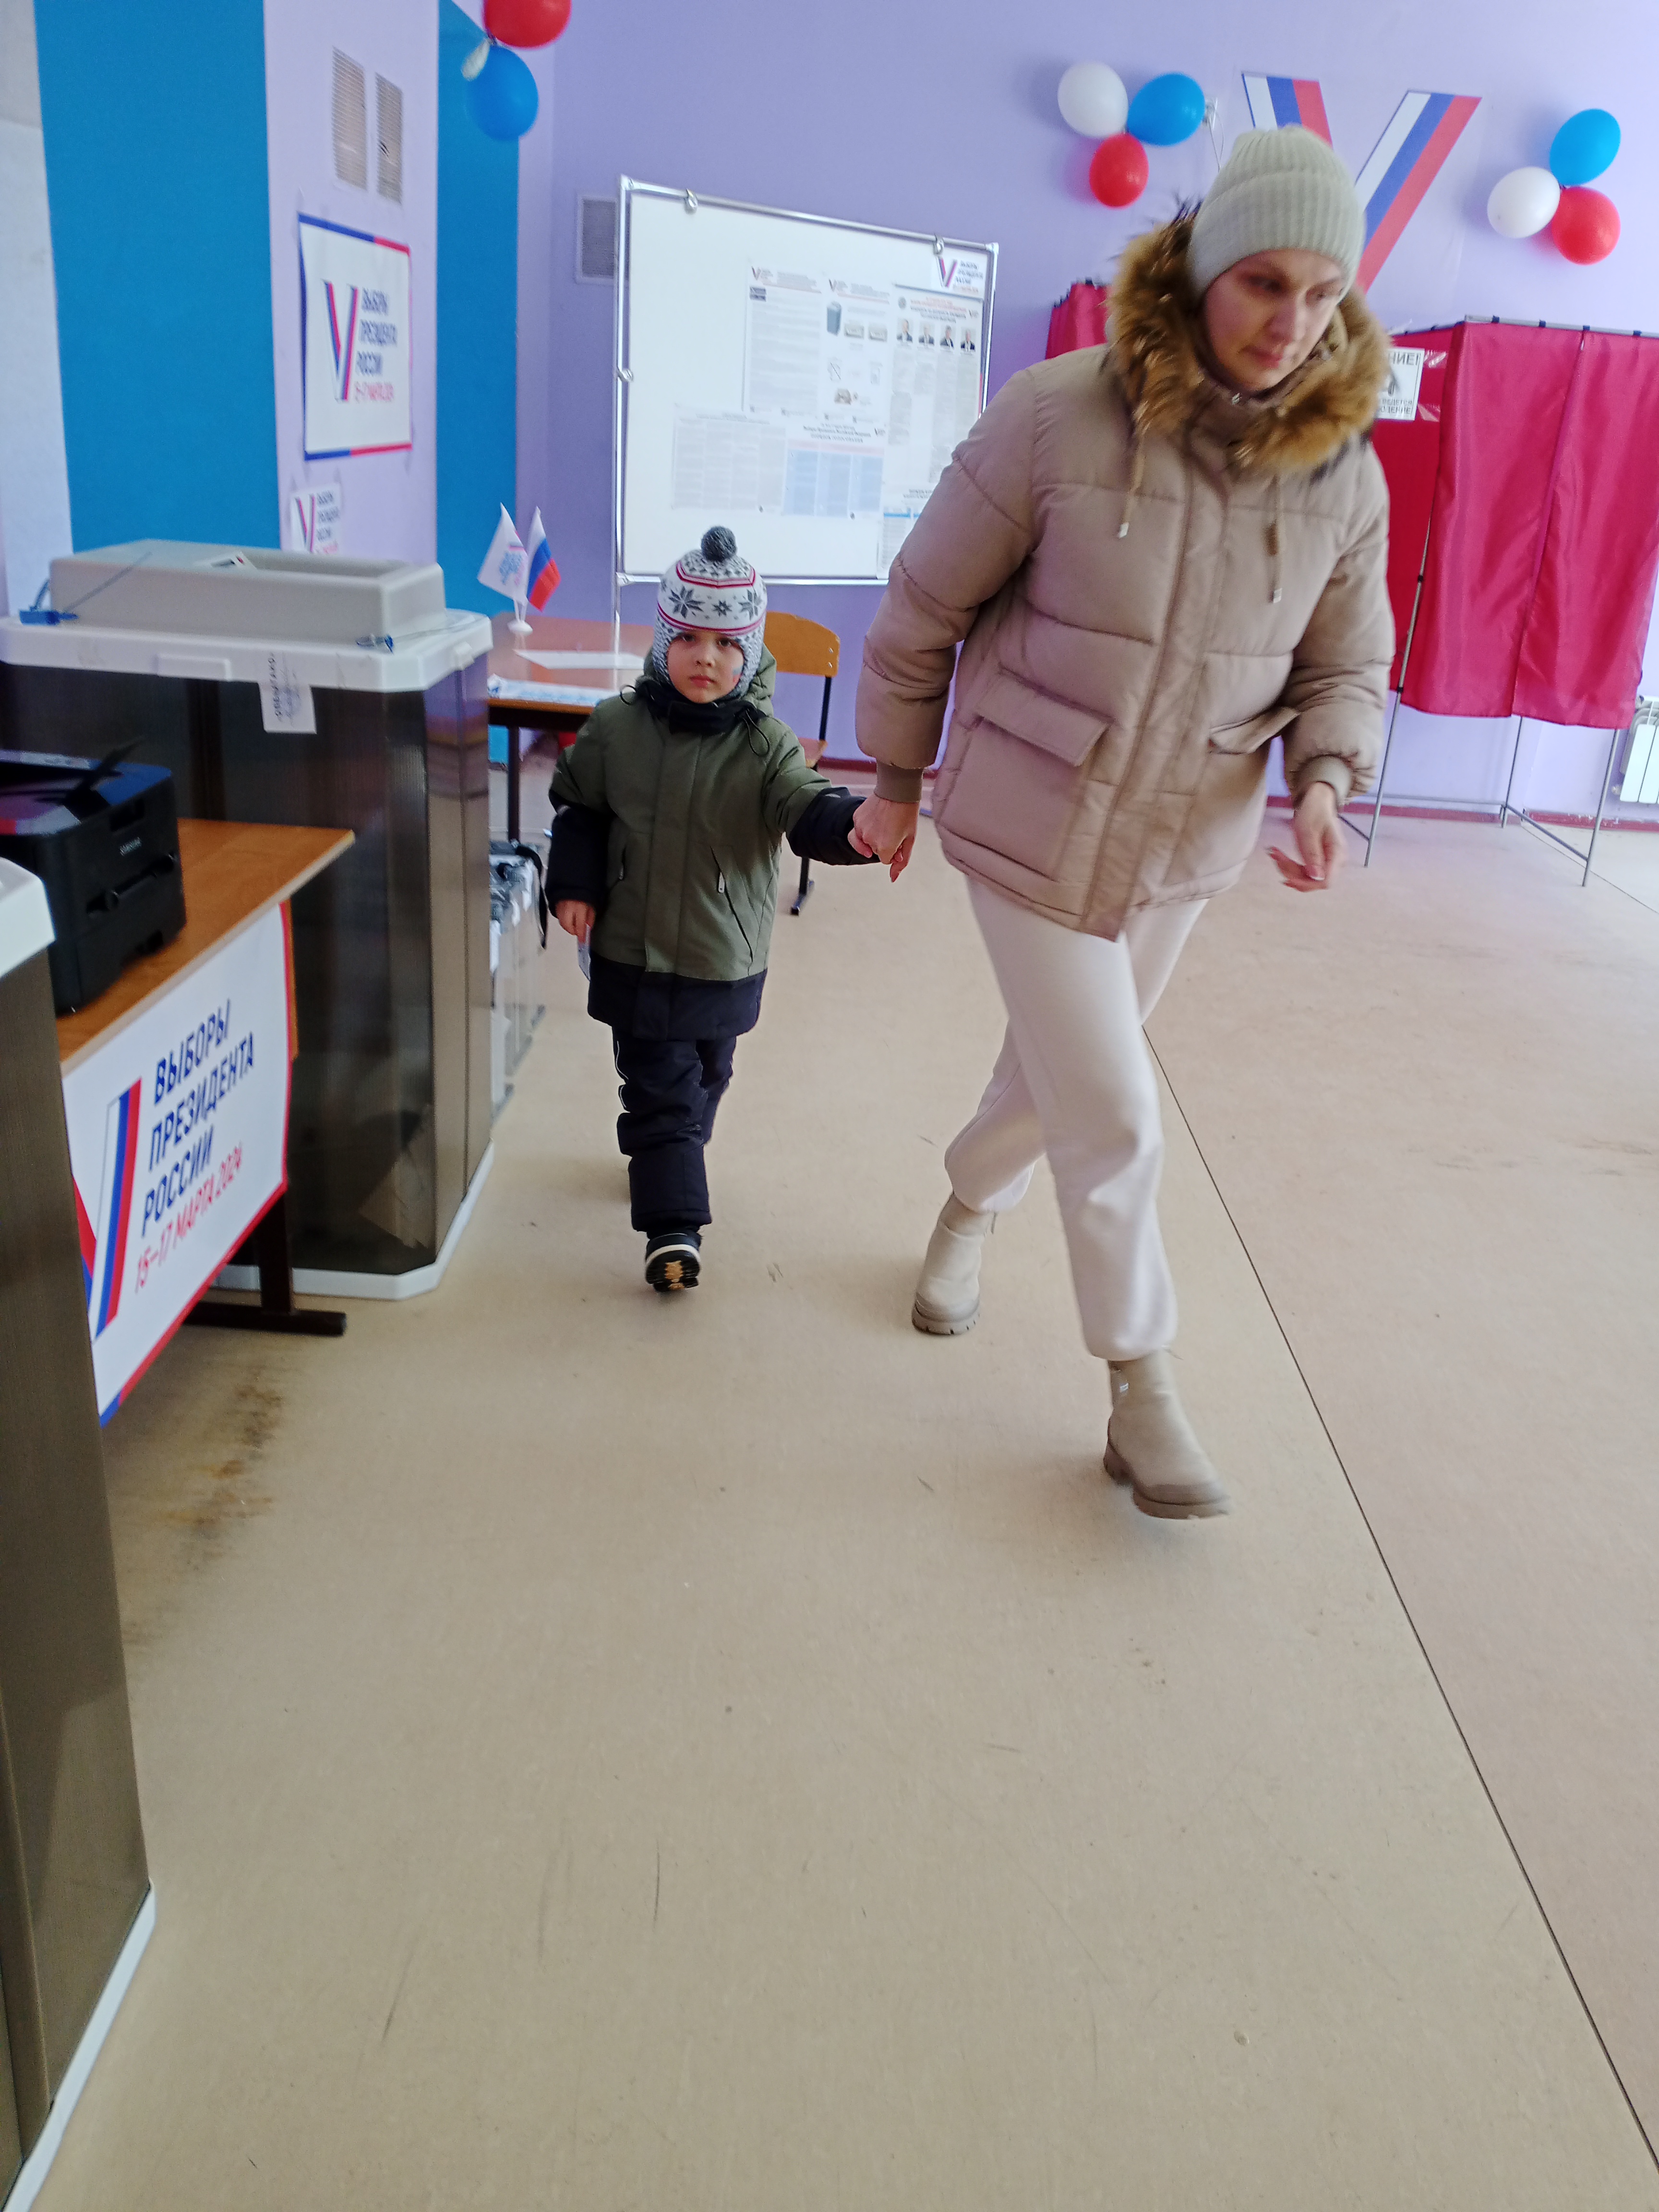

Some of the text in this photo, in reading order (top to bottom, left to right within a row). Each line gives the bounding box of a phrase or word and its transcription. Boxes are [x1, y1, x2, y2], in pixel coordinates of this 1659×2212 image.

[1388, 352, 1419, 366] НИЕ!
[149, 1032, 254, 1173] ПРЕЗИДЕНТА
[154, 998, 230, 1106] ВЫБОРЫ
[141, 1124, 214, 1238] РОССИИ
[173, 1173, 214, 1250] МАРТА
[216, 1140, 242, 1198] 2024
